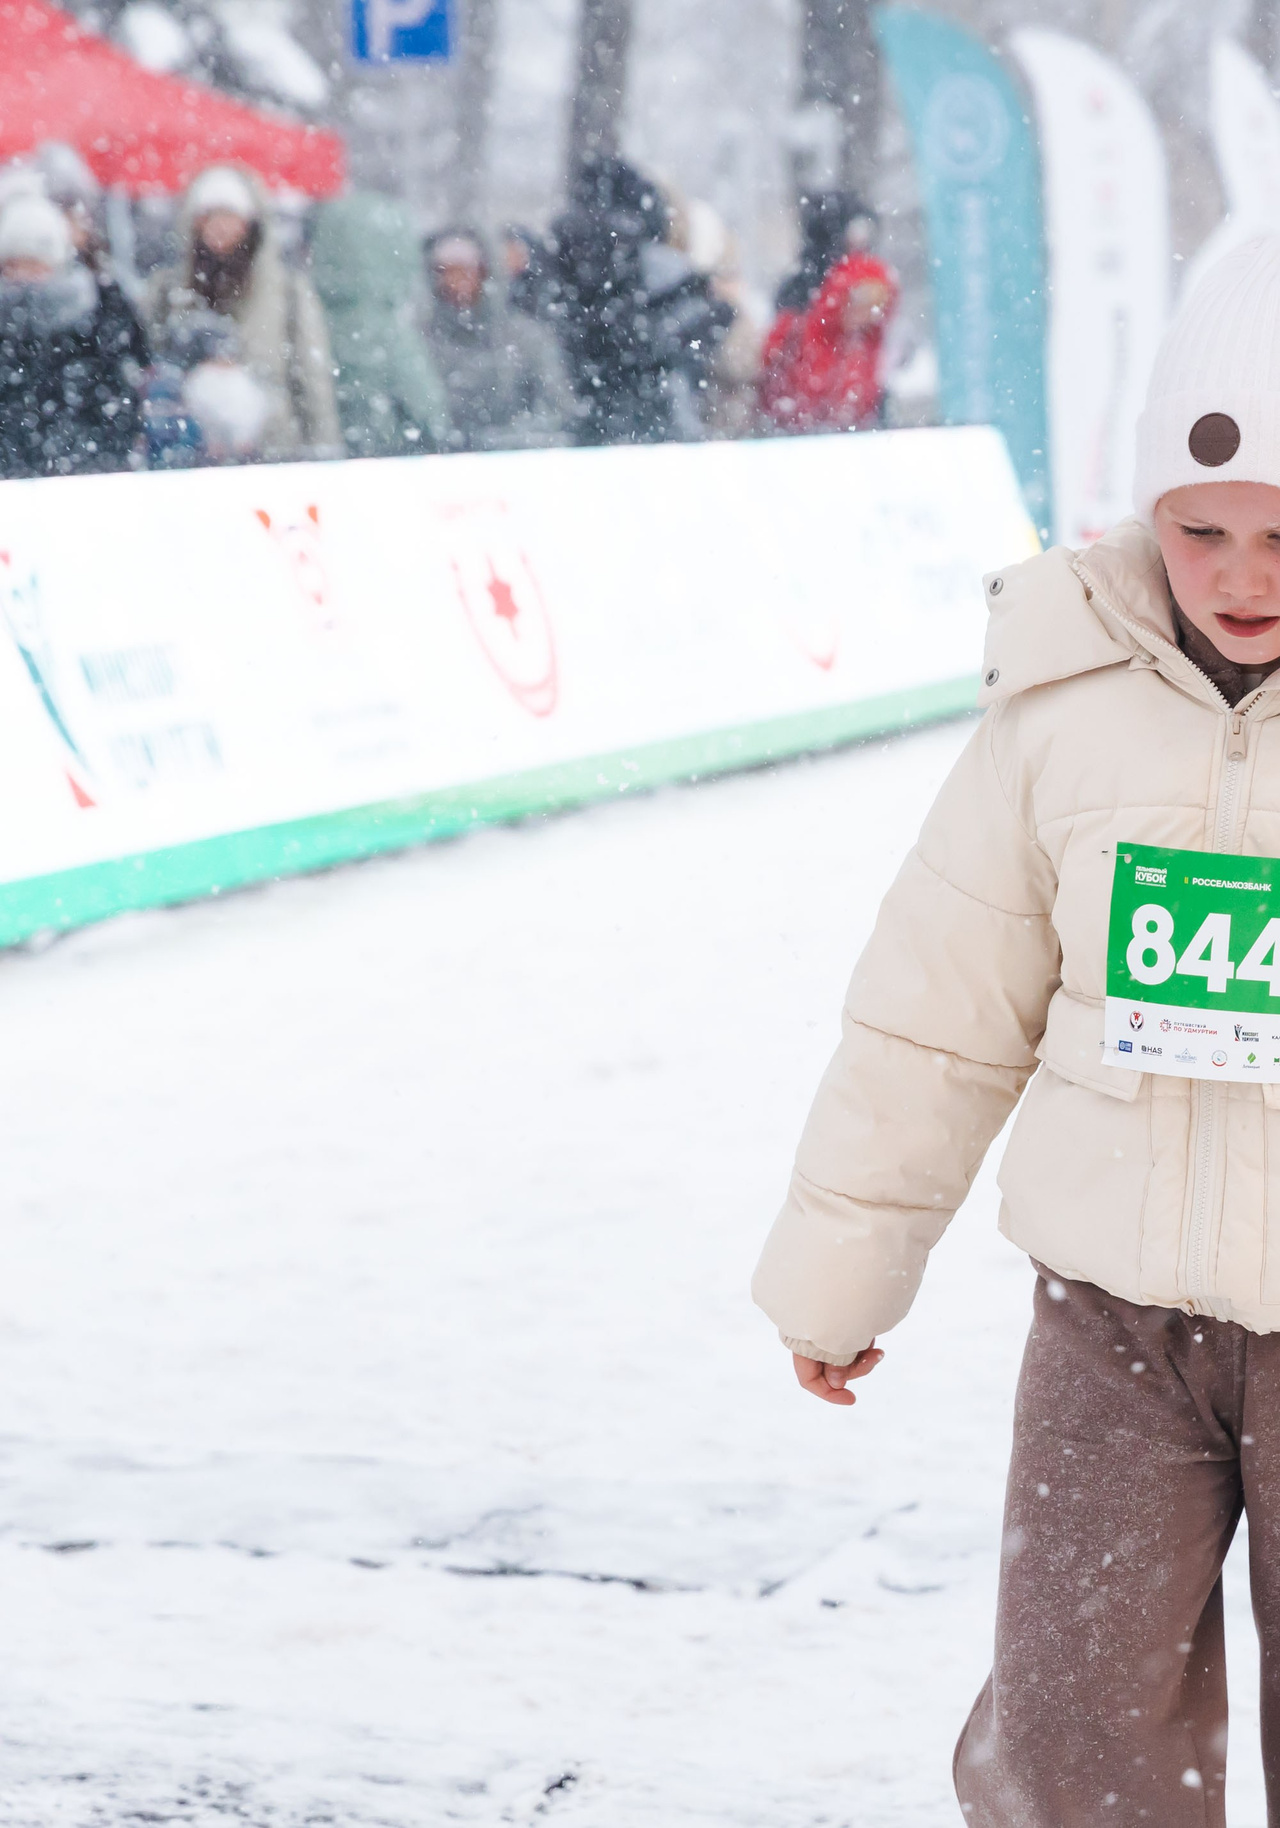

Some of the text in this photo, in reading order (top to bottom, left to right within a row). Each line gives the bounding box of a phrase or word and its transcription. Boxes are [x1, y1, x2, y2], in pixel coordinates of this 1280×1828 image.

[1135, 871, 1167, 884] КУБОК
[1192, 877, 1272, 892] РОССЕЛЬХОЗБАНК
[1184, 1027, 1218, 1035] УДМУРТИИ
[1147, 1046, 1163, 1055] HAS
